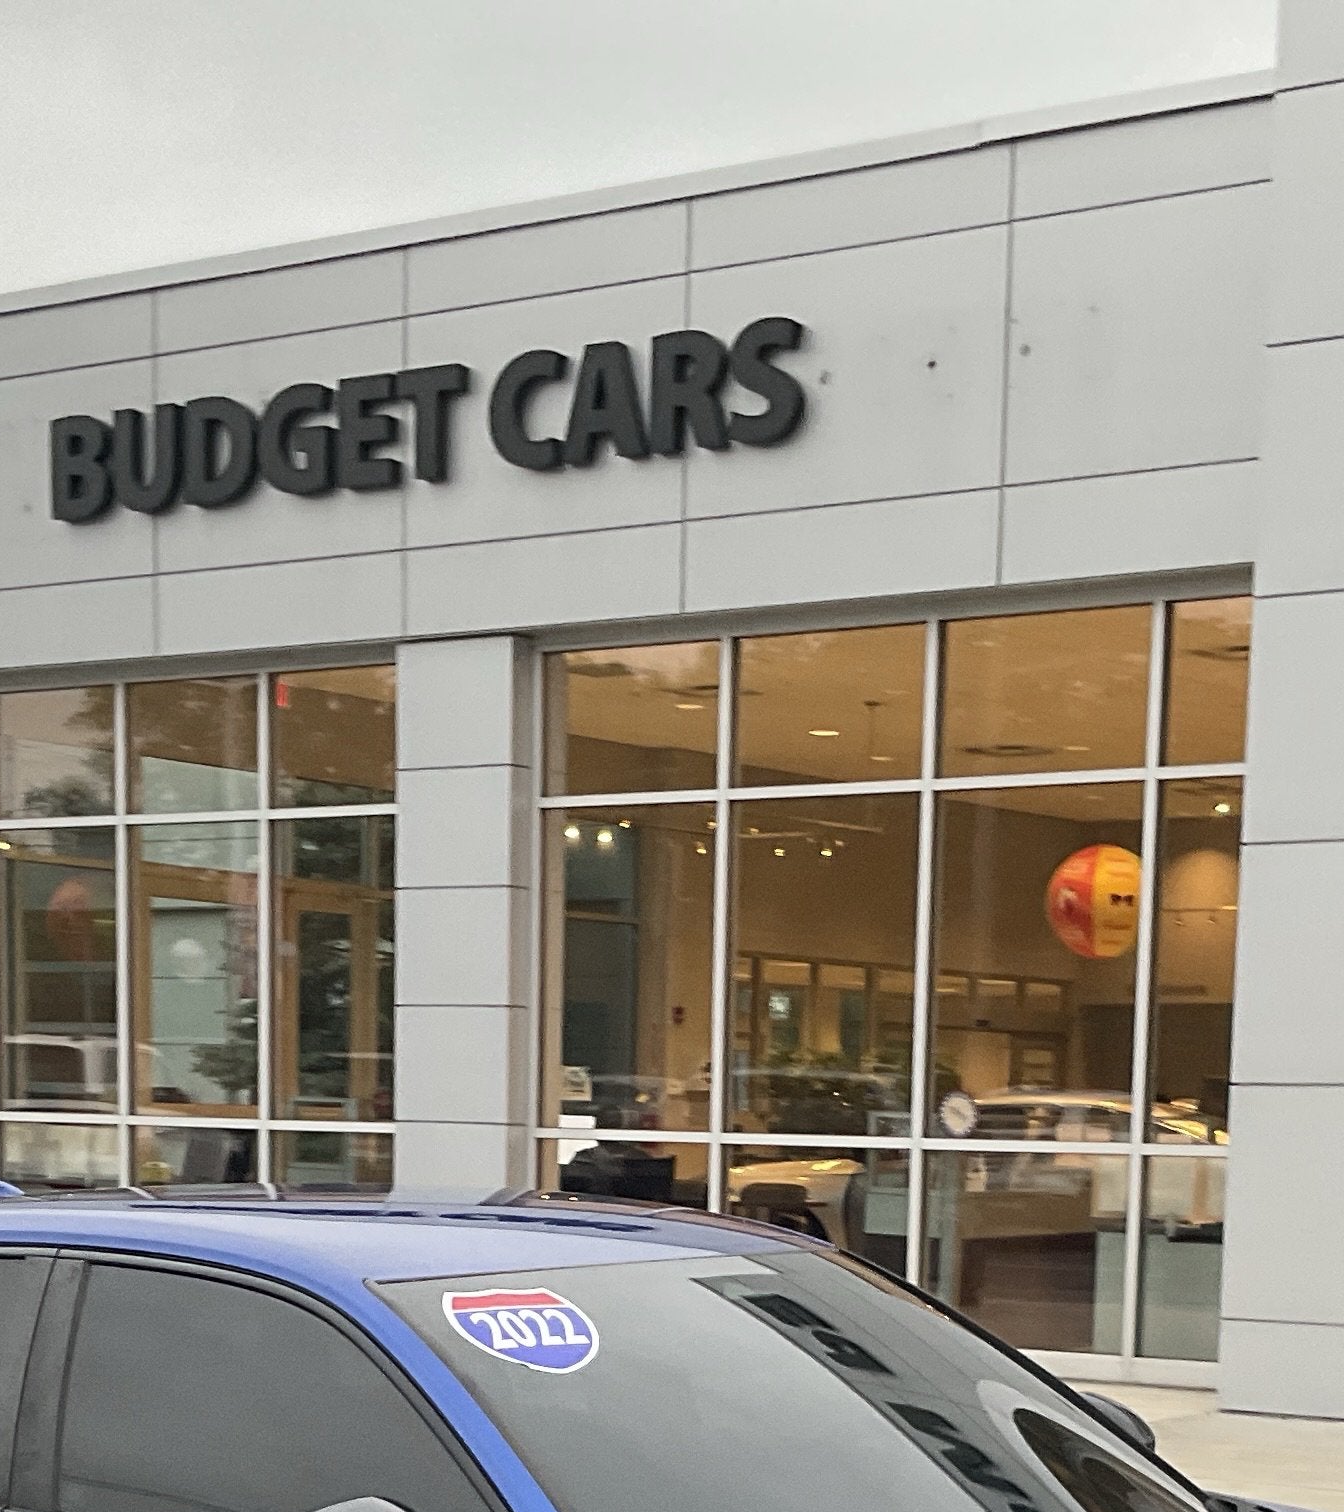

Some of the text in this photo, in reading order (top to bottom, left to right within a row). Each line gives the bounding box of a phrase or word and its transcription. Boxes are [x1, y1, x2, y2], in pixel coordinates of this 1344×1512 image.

[50, 316, 806, 524] BUDGET CARS
[469, 1308, 592, 1350] 2022
